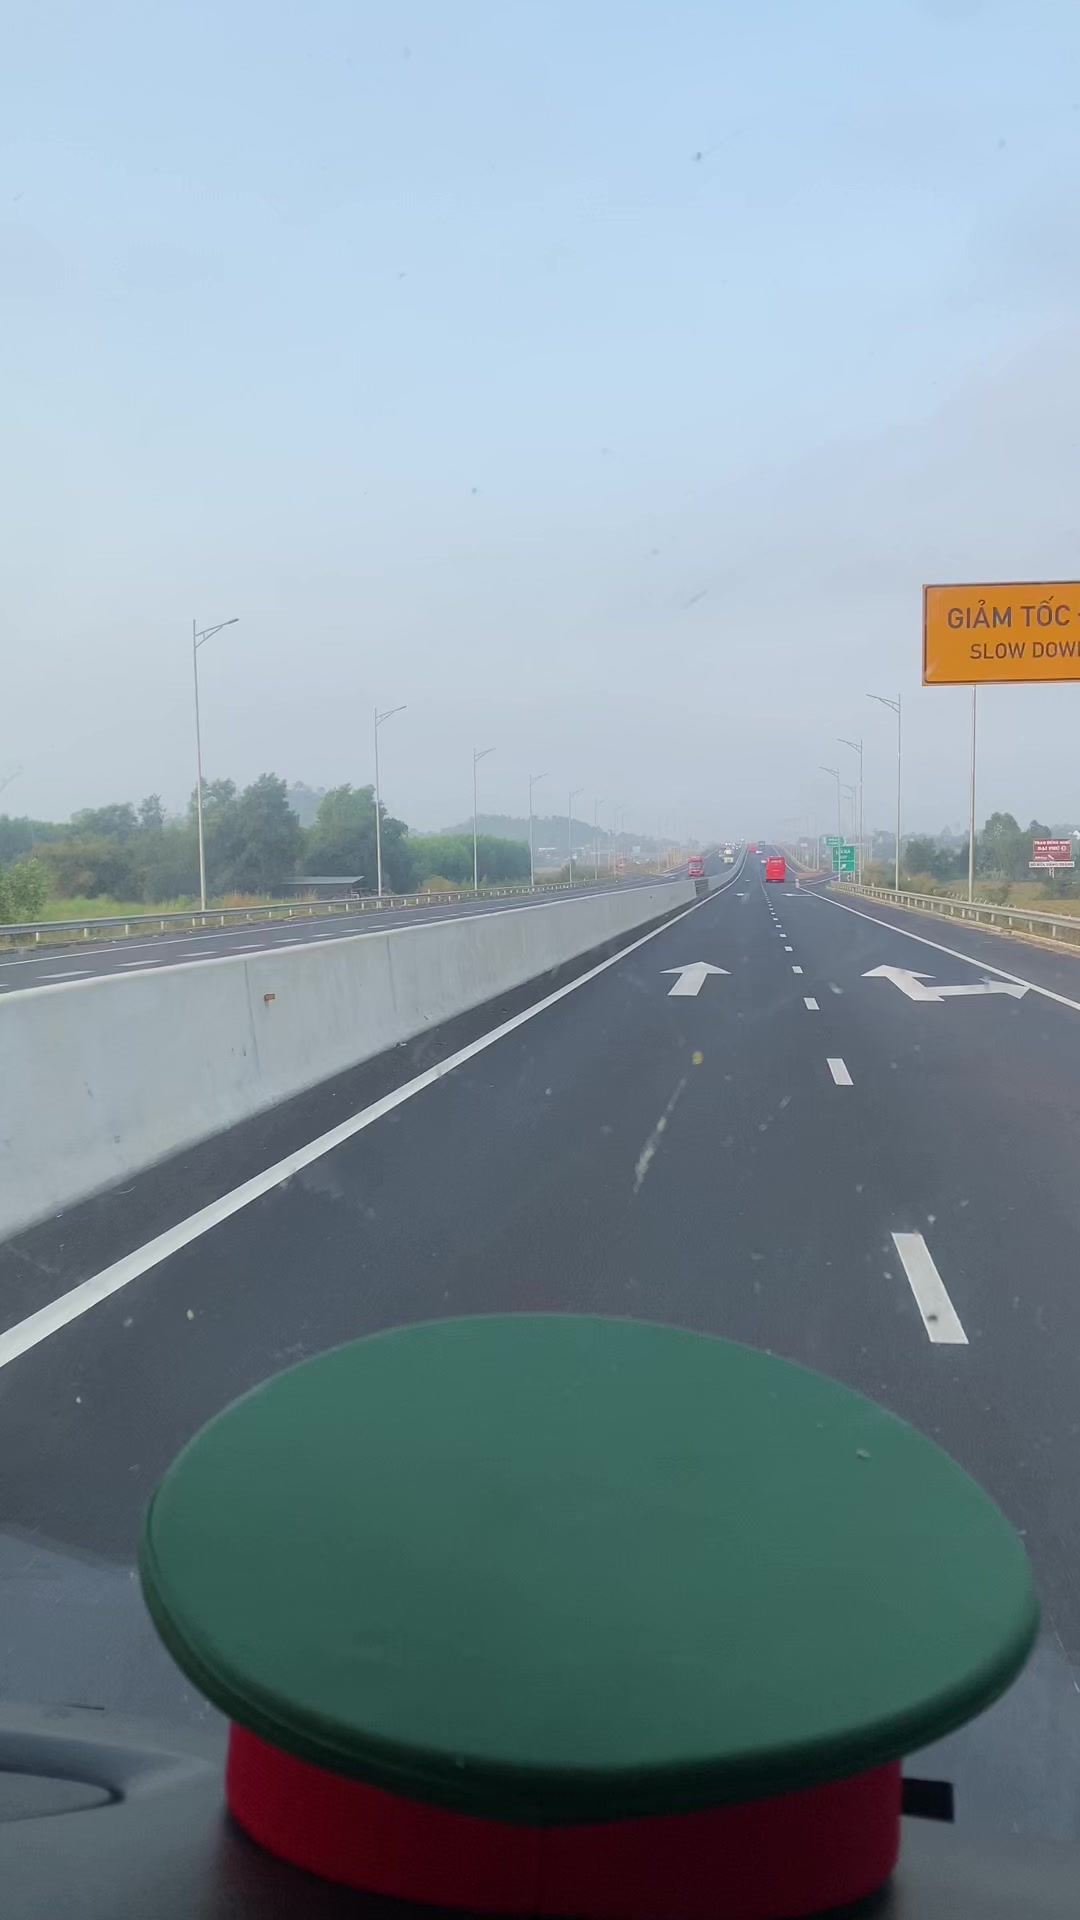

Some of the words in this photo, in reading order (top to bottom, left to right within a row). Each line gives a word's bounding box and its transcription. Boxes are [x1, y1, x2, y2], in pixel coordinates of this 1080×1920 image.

[947, 599, 1012, 629] GIẢM
[1020, 595, 1071, 628] TỐC
[970, 642, 1026, 660] SLOW
